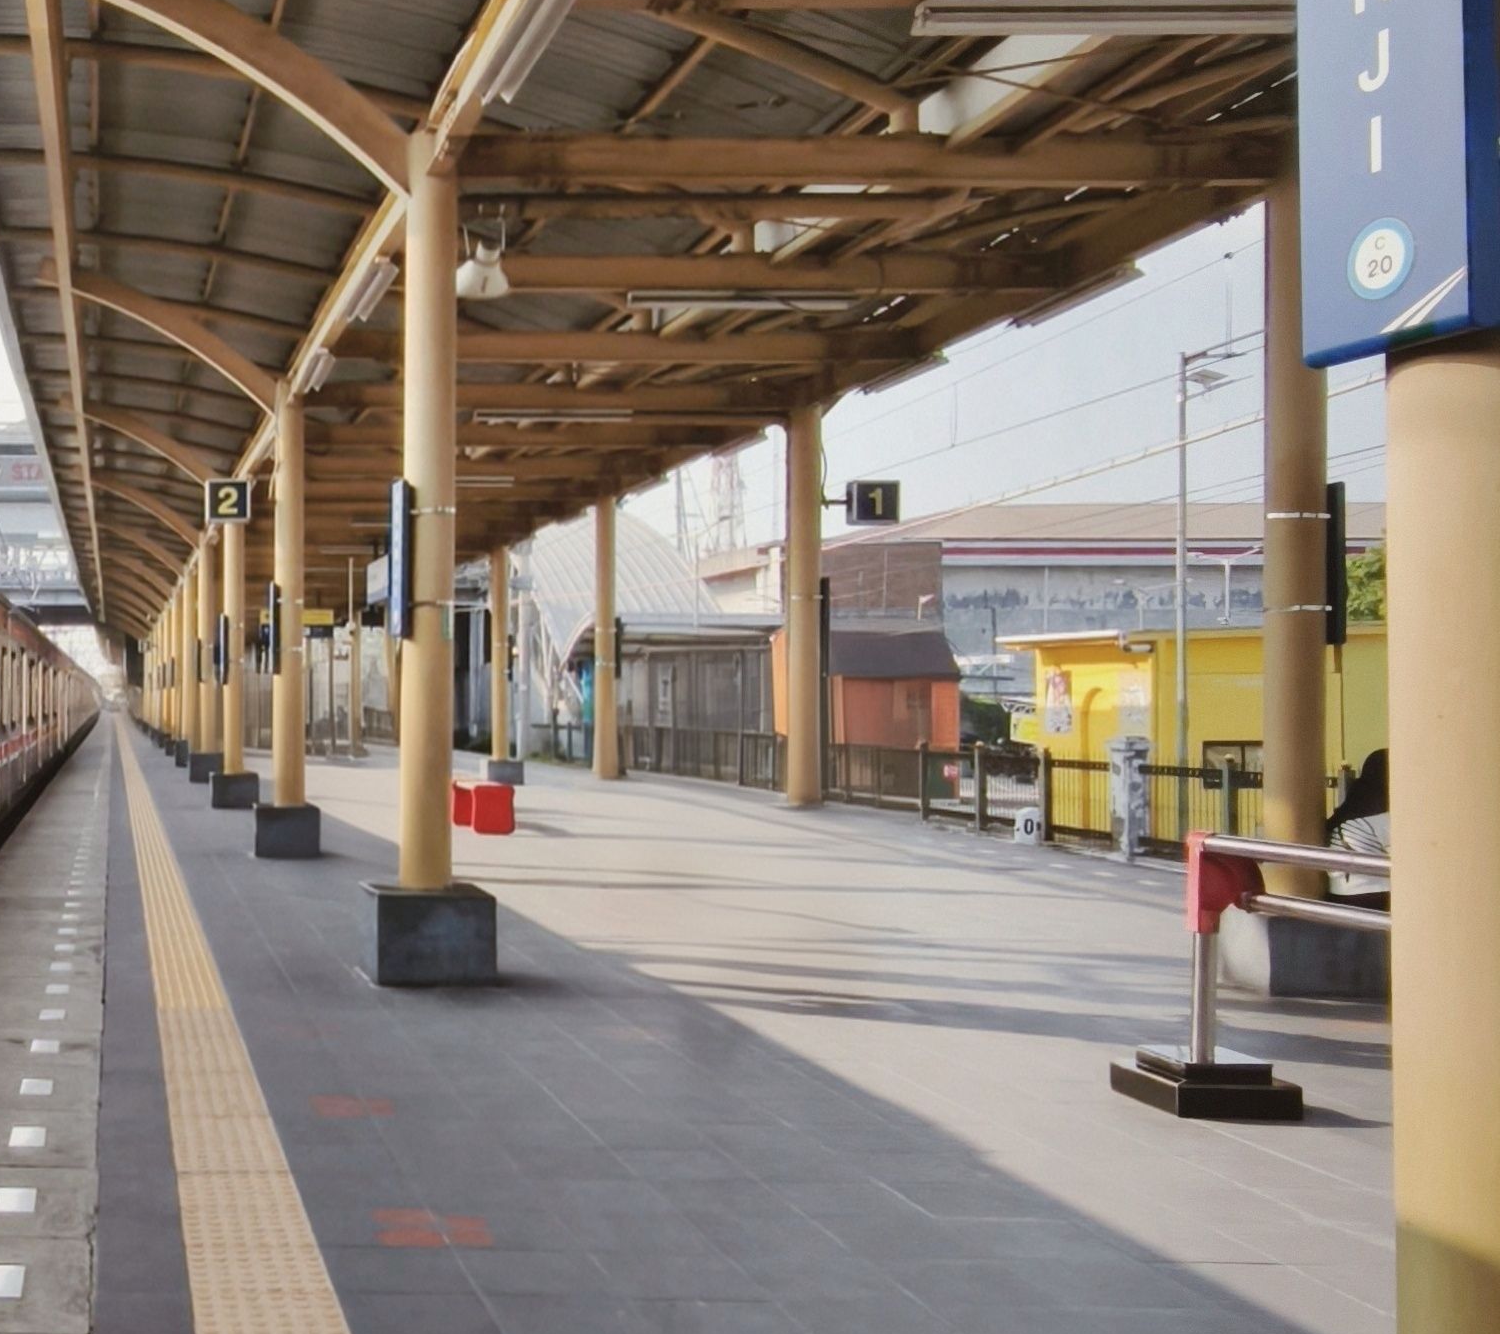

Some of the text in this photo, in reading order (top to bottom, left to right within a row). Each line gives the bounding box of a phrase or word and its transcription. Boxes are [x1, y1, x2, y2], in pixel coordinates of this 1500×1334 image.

[1374, 235, 1387, 250] C
[1367, 255, 1393, 278] 20
[217, 485, 239, 515] 2
[868, 487, 883, 515] 1
